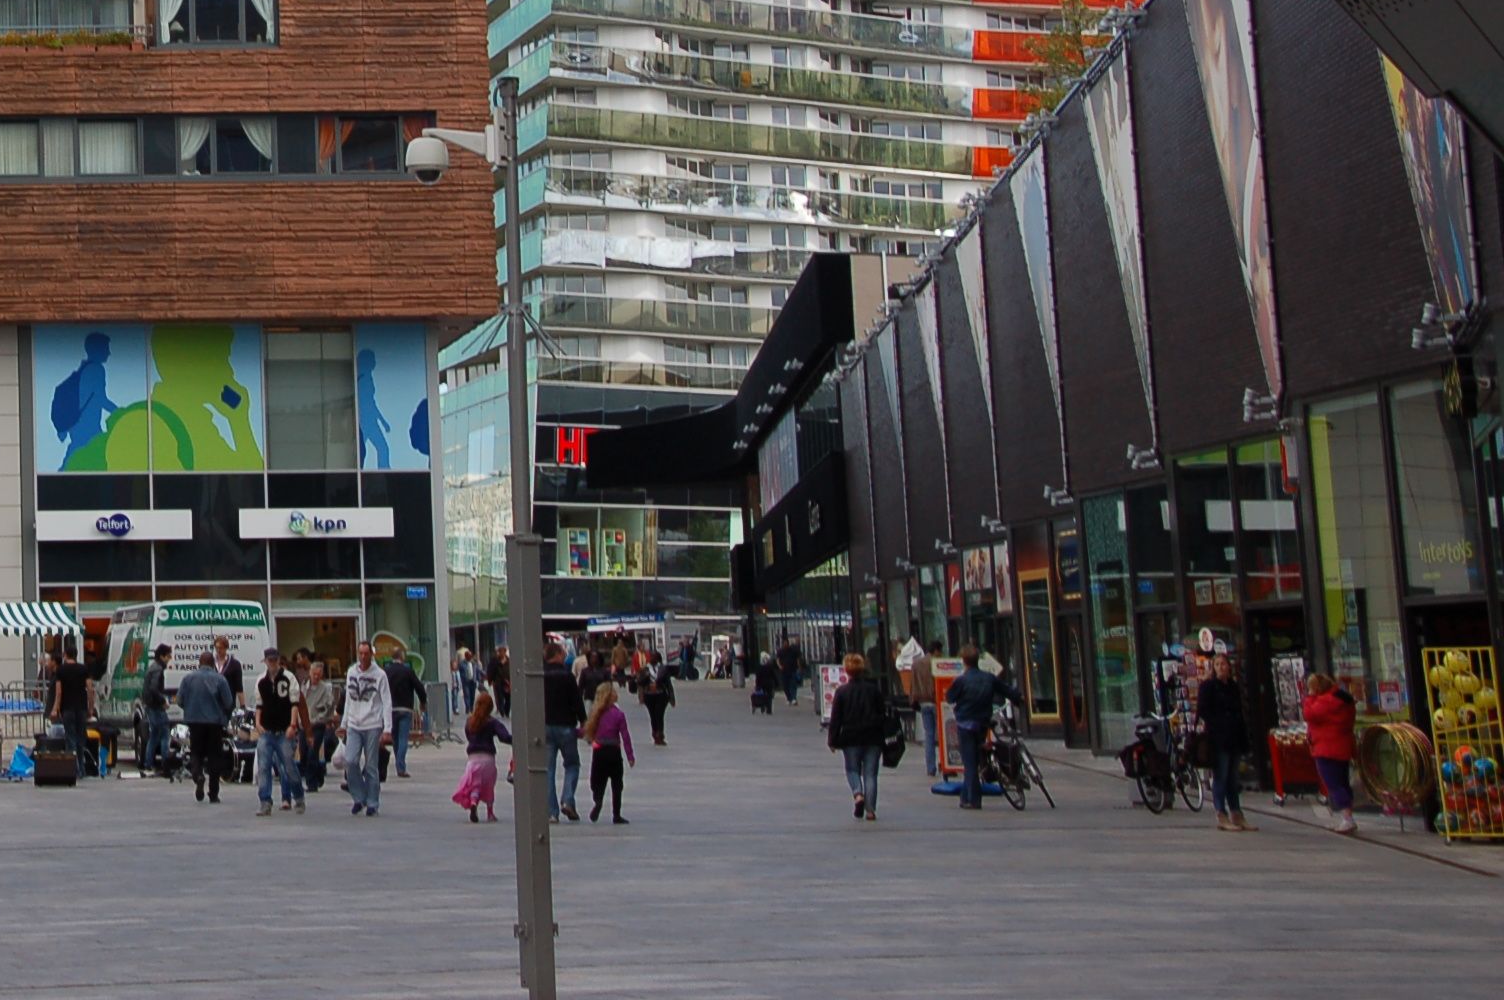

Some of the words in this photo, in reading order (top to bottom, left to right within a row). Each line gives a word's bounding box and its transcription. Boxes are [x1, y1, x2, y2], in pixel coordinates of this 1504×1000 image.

[97, 519, 130, 530] Telfort
[314, 516, 347, 534] kpn
[1418, 538, 1473, 565] Intertoys
[172, 608, 264, 621] AUTORADAM.nl
